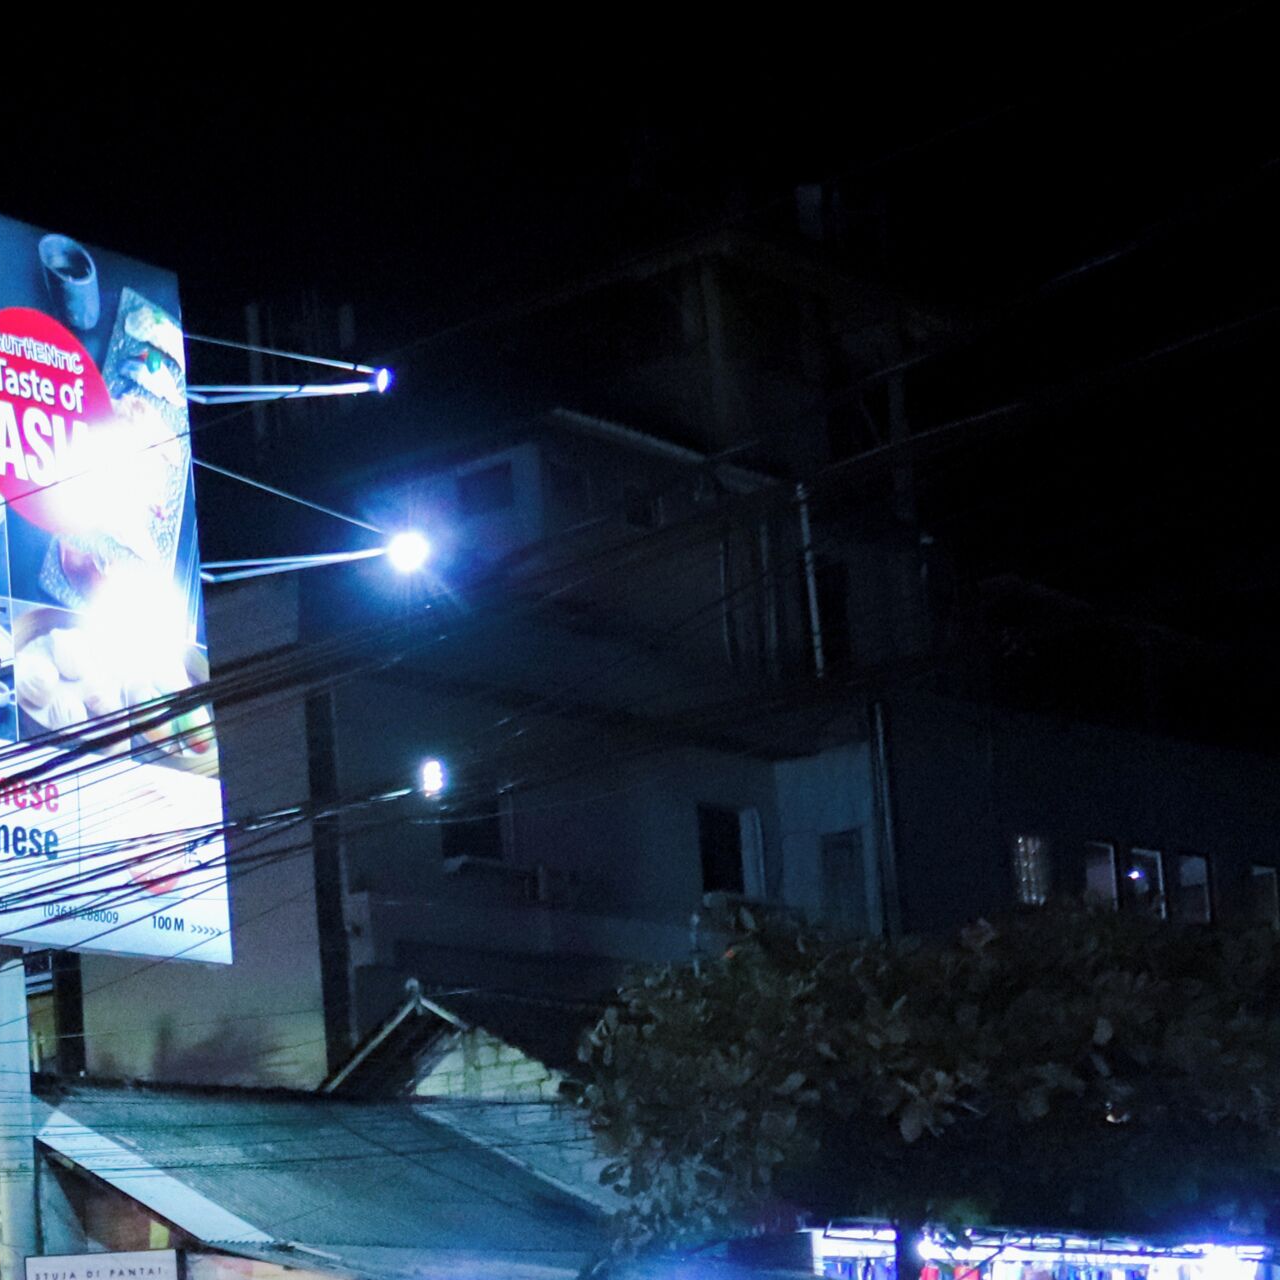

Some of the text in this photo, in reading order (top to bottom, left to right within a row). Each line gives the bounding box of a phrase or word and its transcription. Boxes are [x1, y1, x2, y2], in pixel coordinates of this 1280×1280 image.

[60, 379, 84, 413] of
[152, 916, 184, 931] 100 M
